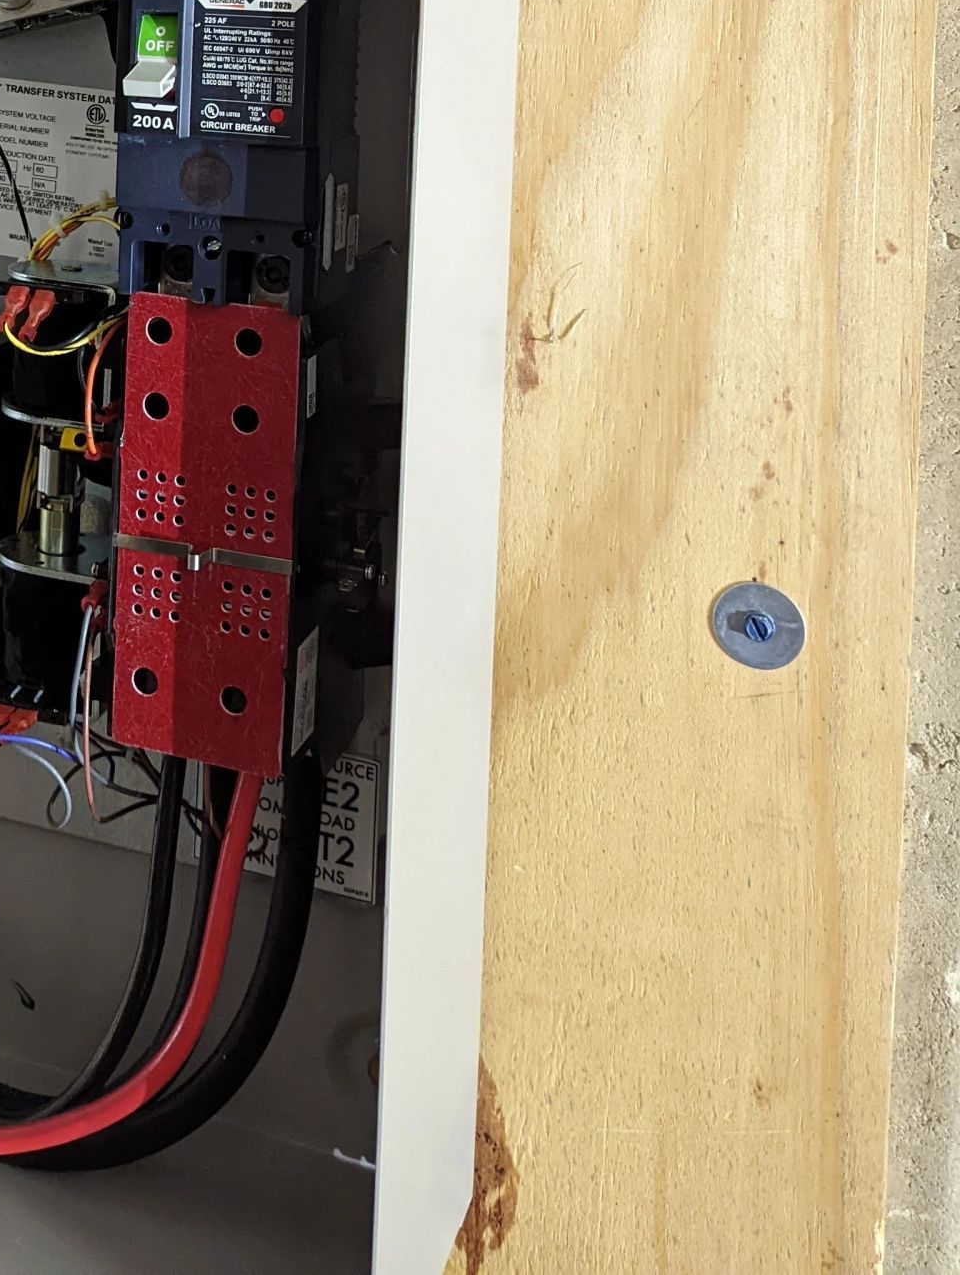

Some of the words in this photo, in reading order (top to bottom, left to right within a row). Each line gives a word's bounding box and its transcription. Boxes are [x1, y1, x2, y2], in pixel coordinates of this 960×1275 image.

[213, 28, 247, 36] Interrupting
[146, 39, 175, 52] OFF
[5, 83, 54, 98] TRANSFER
[56, 90, 95, 103] SYSTEM
[25, 112, 56, 122] VOLTAGE
[20, 125, 49, 135] NUMBER
[200, 121, 233, 130] CIRCUIT
[234, 123, 275, 133] BREAKER
[18, 138, 48, 148] NUMBER
[38, 154, 56, 163] DATE
